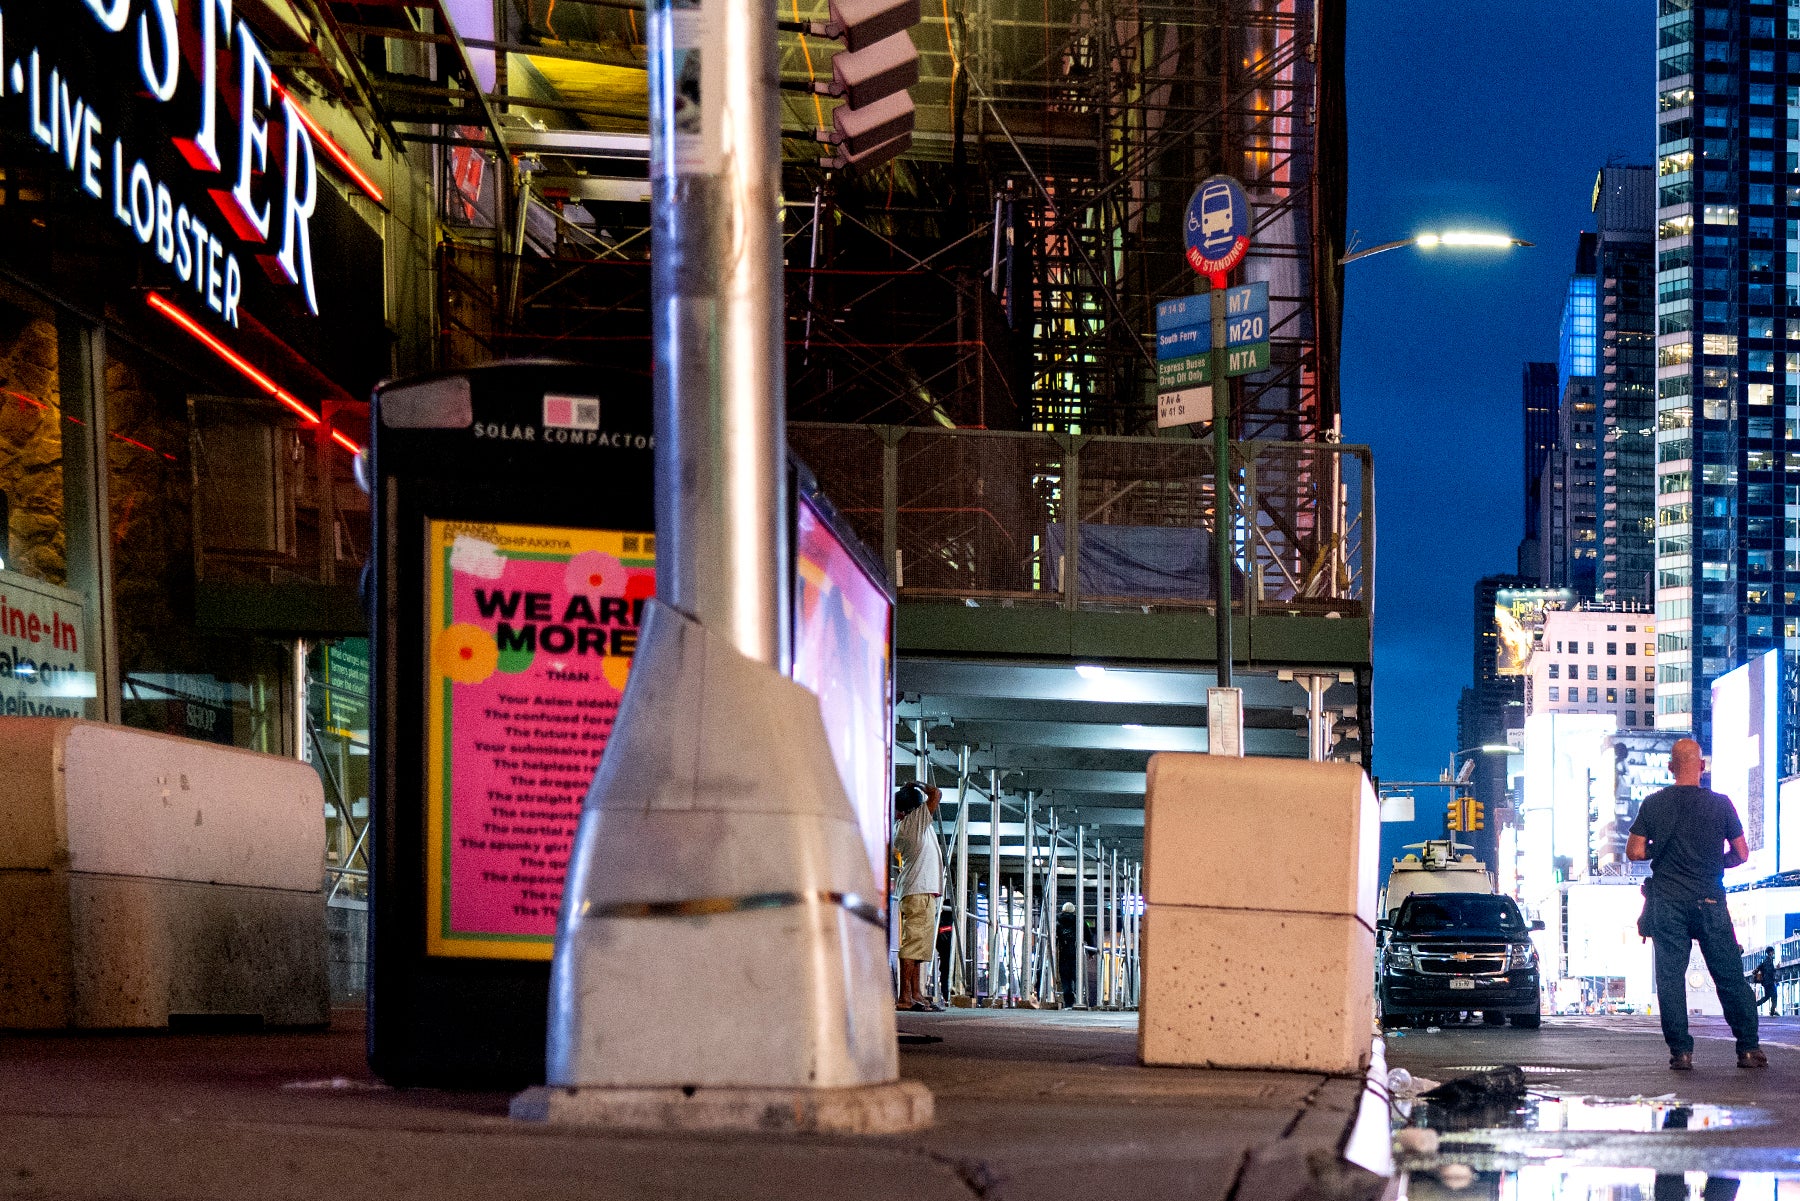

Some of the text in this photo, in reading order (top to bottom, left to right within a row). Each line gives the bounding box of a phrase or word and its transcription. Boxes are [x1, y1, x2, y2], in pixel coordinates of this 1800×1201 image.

[31, 48, 241, 329] LIVE LOBSTER
[1190, 239, 1244, 273] NO STANDING
[1229, 289, 1252, 313] M7
[1160, 329, 1197, 346] South Ferry
[1229, 316, 1263, 342] M20
[1159, 362, 1184, 375] Express
[1229, 351, 1257, 371] MTA
[474, 422, 535, 441] SOLAR
[473, 588, 552, 622] WE
[0, 594, 78, 654] ine-In
[497, 621, 640, 658] MORE
